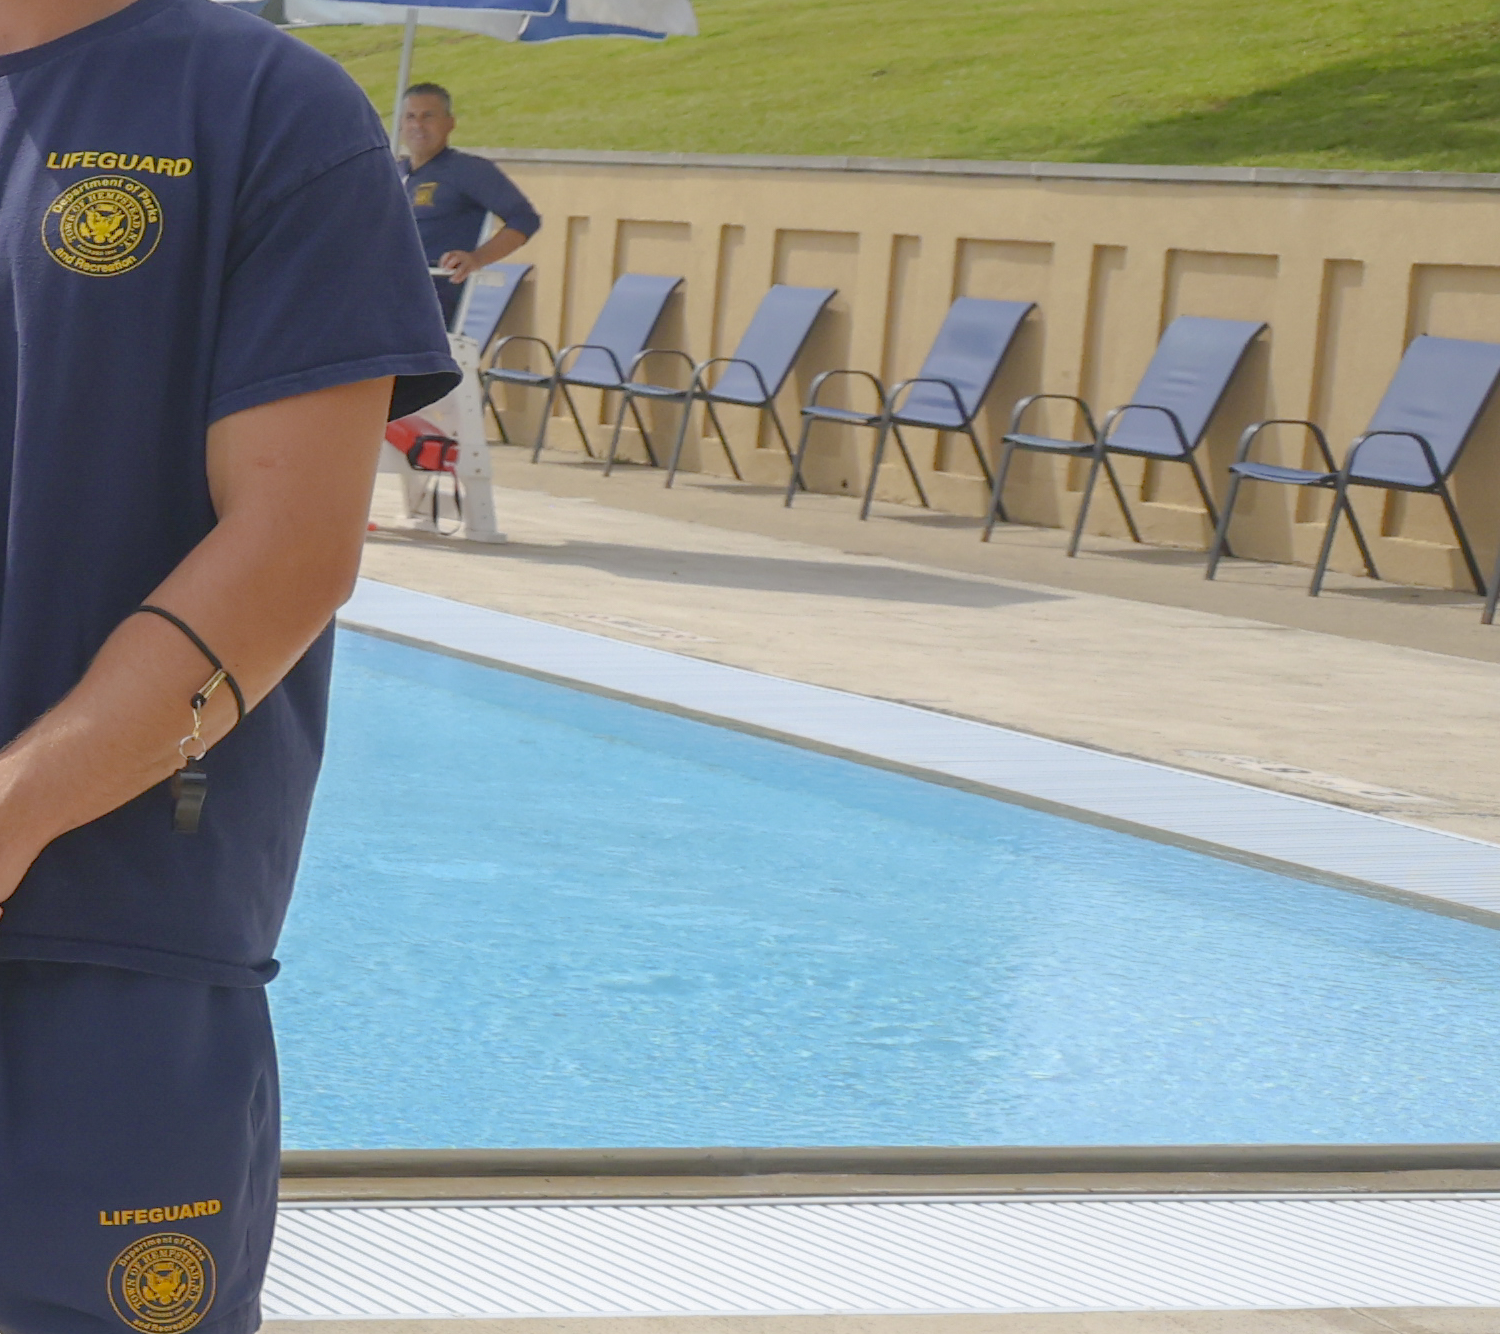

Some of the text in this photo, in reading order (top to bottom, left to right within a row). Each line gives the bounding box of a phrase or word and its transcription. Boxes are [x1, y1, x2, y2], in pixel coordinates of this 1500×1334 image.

[46, 151, 192, 177] LIFEGUARD
[51, 179, 158, 223] Department of Parks
[54, 248, 76, 264] and
[99, 1199, 222, 1226] LIFEGUARD
